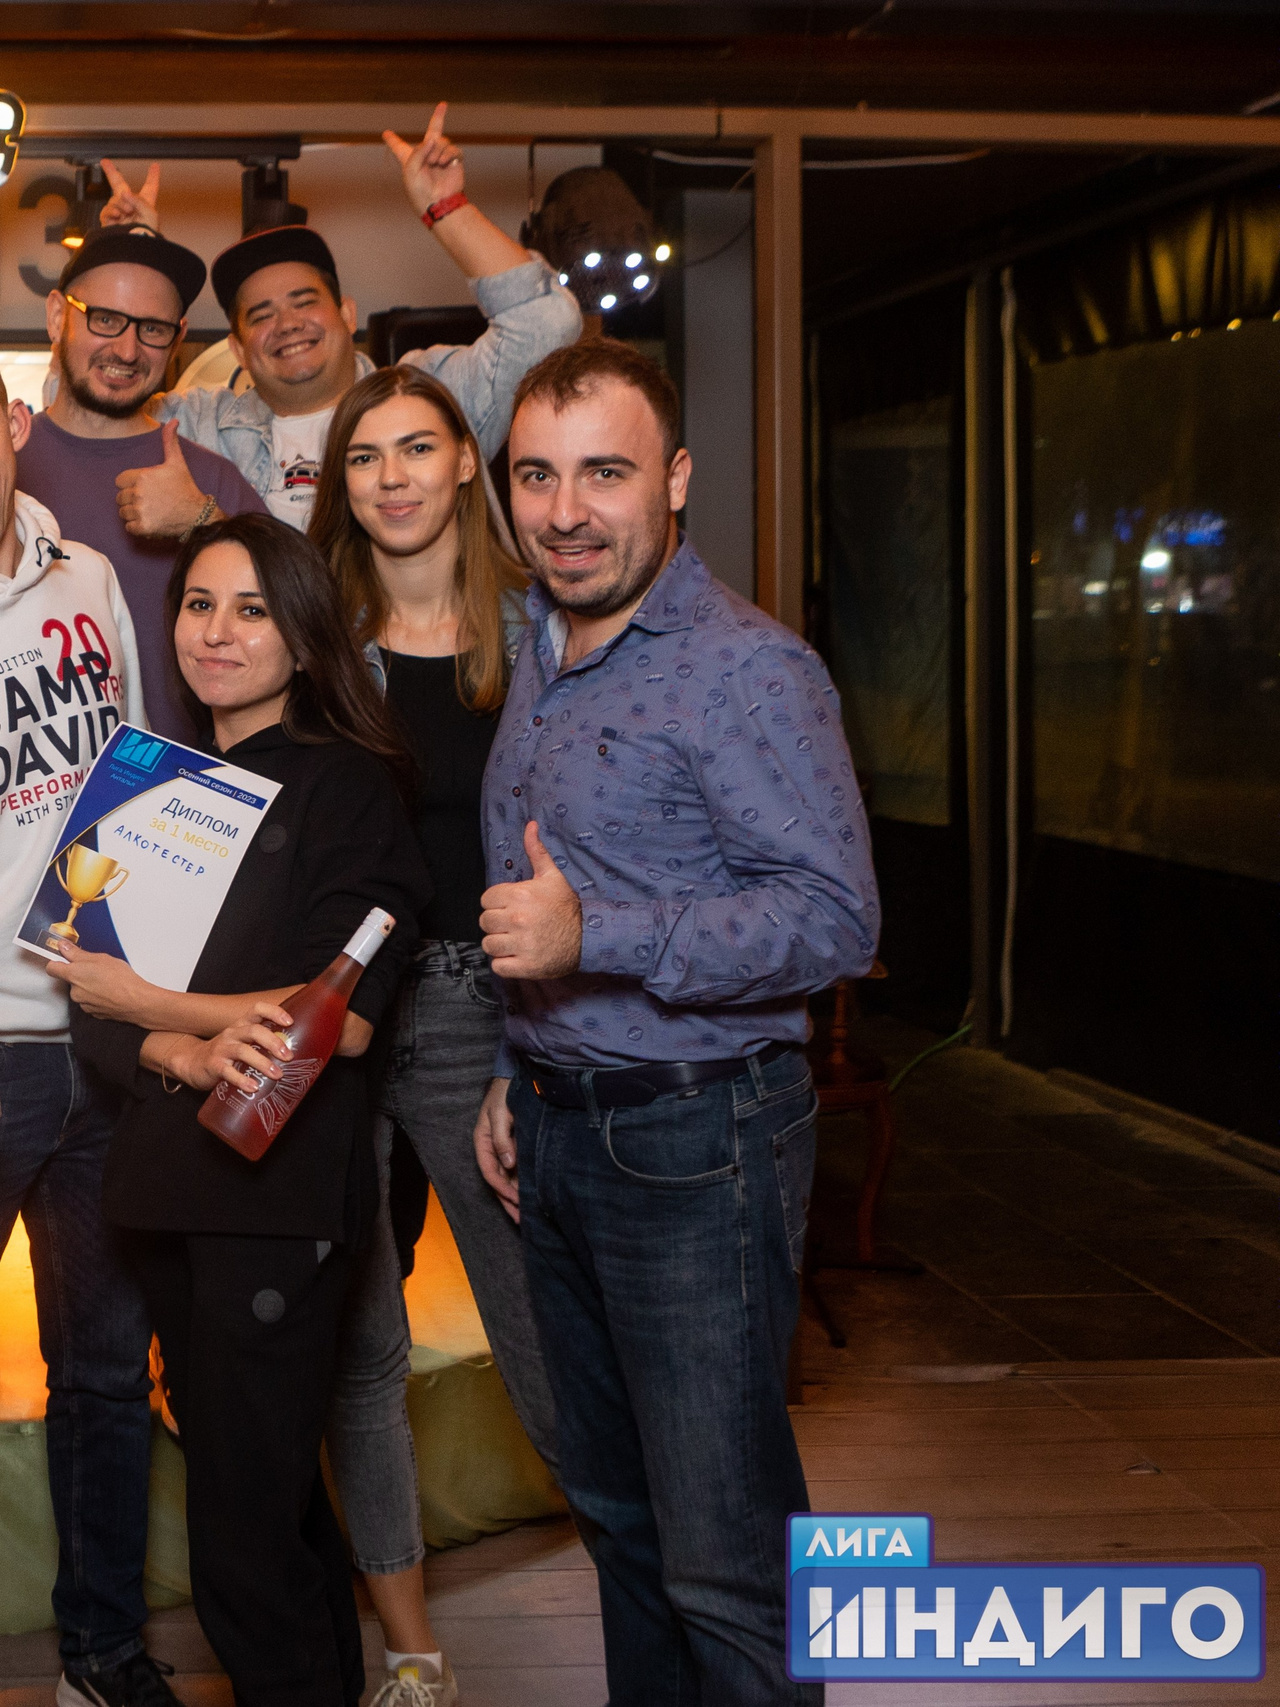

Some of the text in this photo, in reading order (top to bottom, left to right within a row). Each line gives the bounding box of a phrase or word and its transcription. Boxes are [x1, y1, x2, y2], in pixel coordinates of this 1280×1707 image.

[41, 613, 112, 682] 20
[1, 767, 90, 815] PERFORM
[177, 767, 210, 787] Осенний
[210, 780, 233, 795] сезон
[237, 792, 258, 805] 2023
[16, 792, 77, 827] WITH STY
[160, 797, 240, 839] Диплом
[114, 824, 206, 877] АЛКОТЕСТЕР
[149, 817, 229, 859] за 1 место
